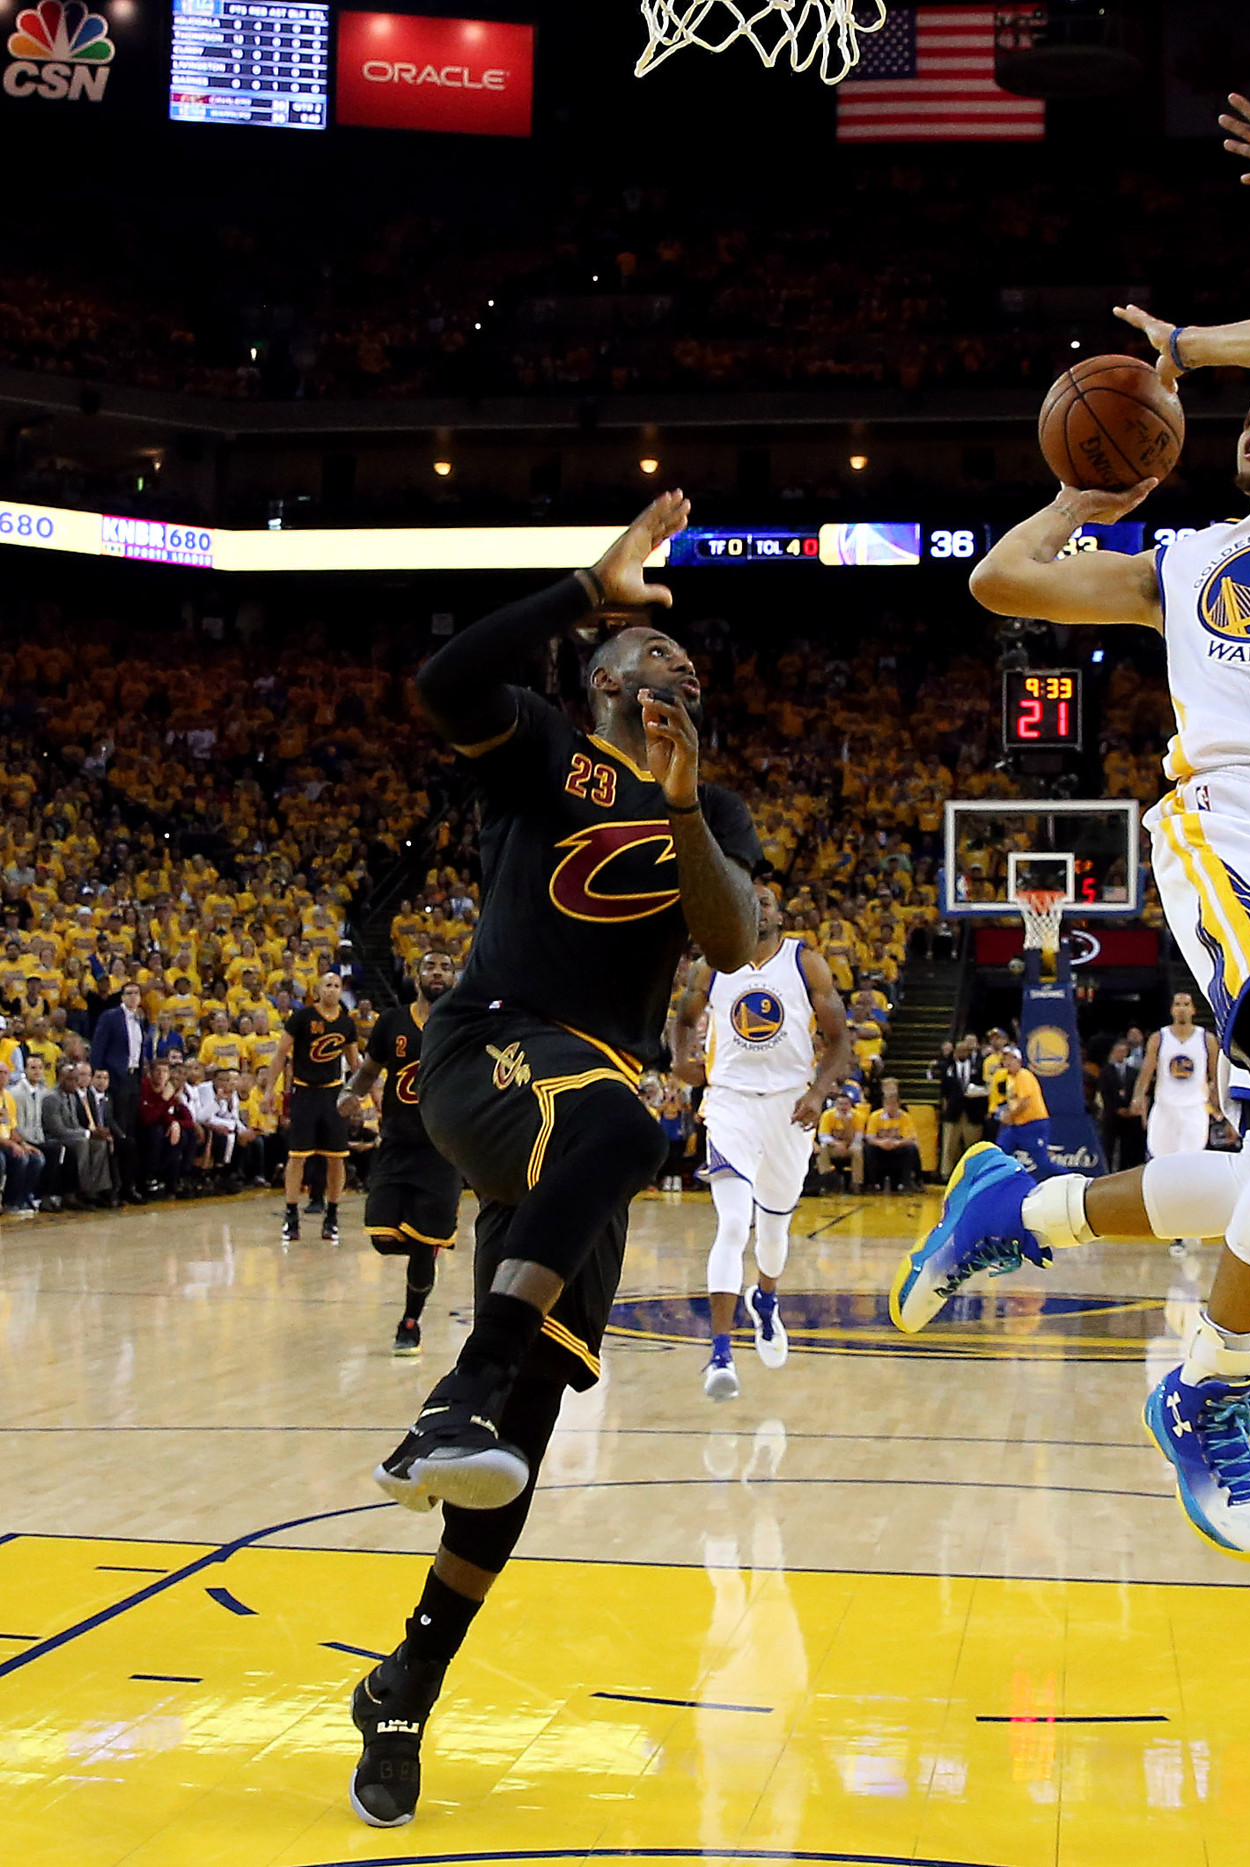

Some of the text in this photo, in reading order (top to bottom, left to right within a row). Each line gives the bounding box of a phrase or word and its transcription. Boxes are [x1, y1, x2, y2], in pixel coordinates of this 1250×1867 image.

[3, 61, 111, 101] CSN
[362, 60, 506, 91] ORACLE
[170, 529, 211, 551] 680
[709, 538, 743, 555] TF 0
[757, 538, 819, 556] TOL 4 0
[930, 530, 974, 558] 36
[1025, 677, 1072, 699] 9:33
[1017, 699, 1069, 739] 21
[565, 752, 617, 808] 23
[761, 998, 773, 1014] 9
[395, 1035, 408, 1058] 2
